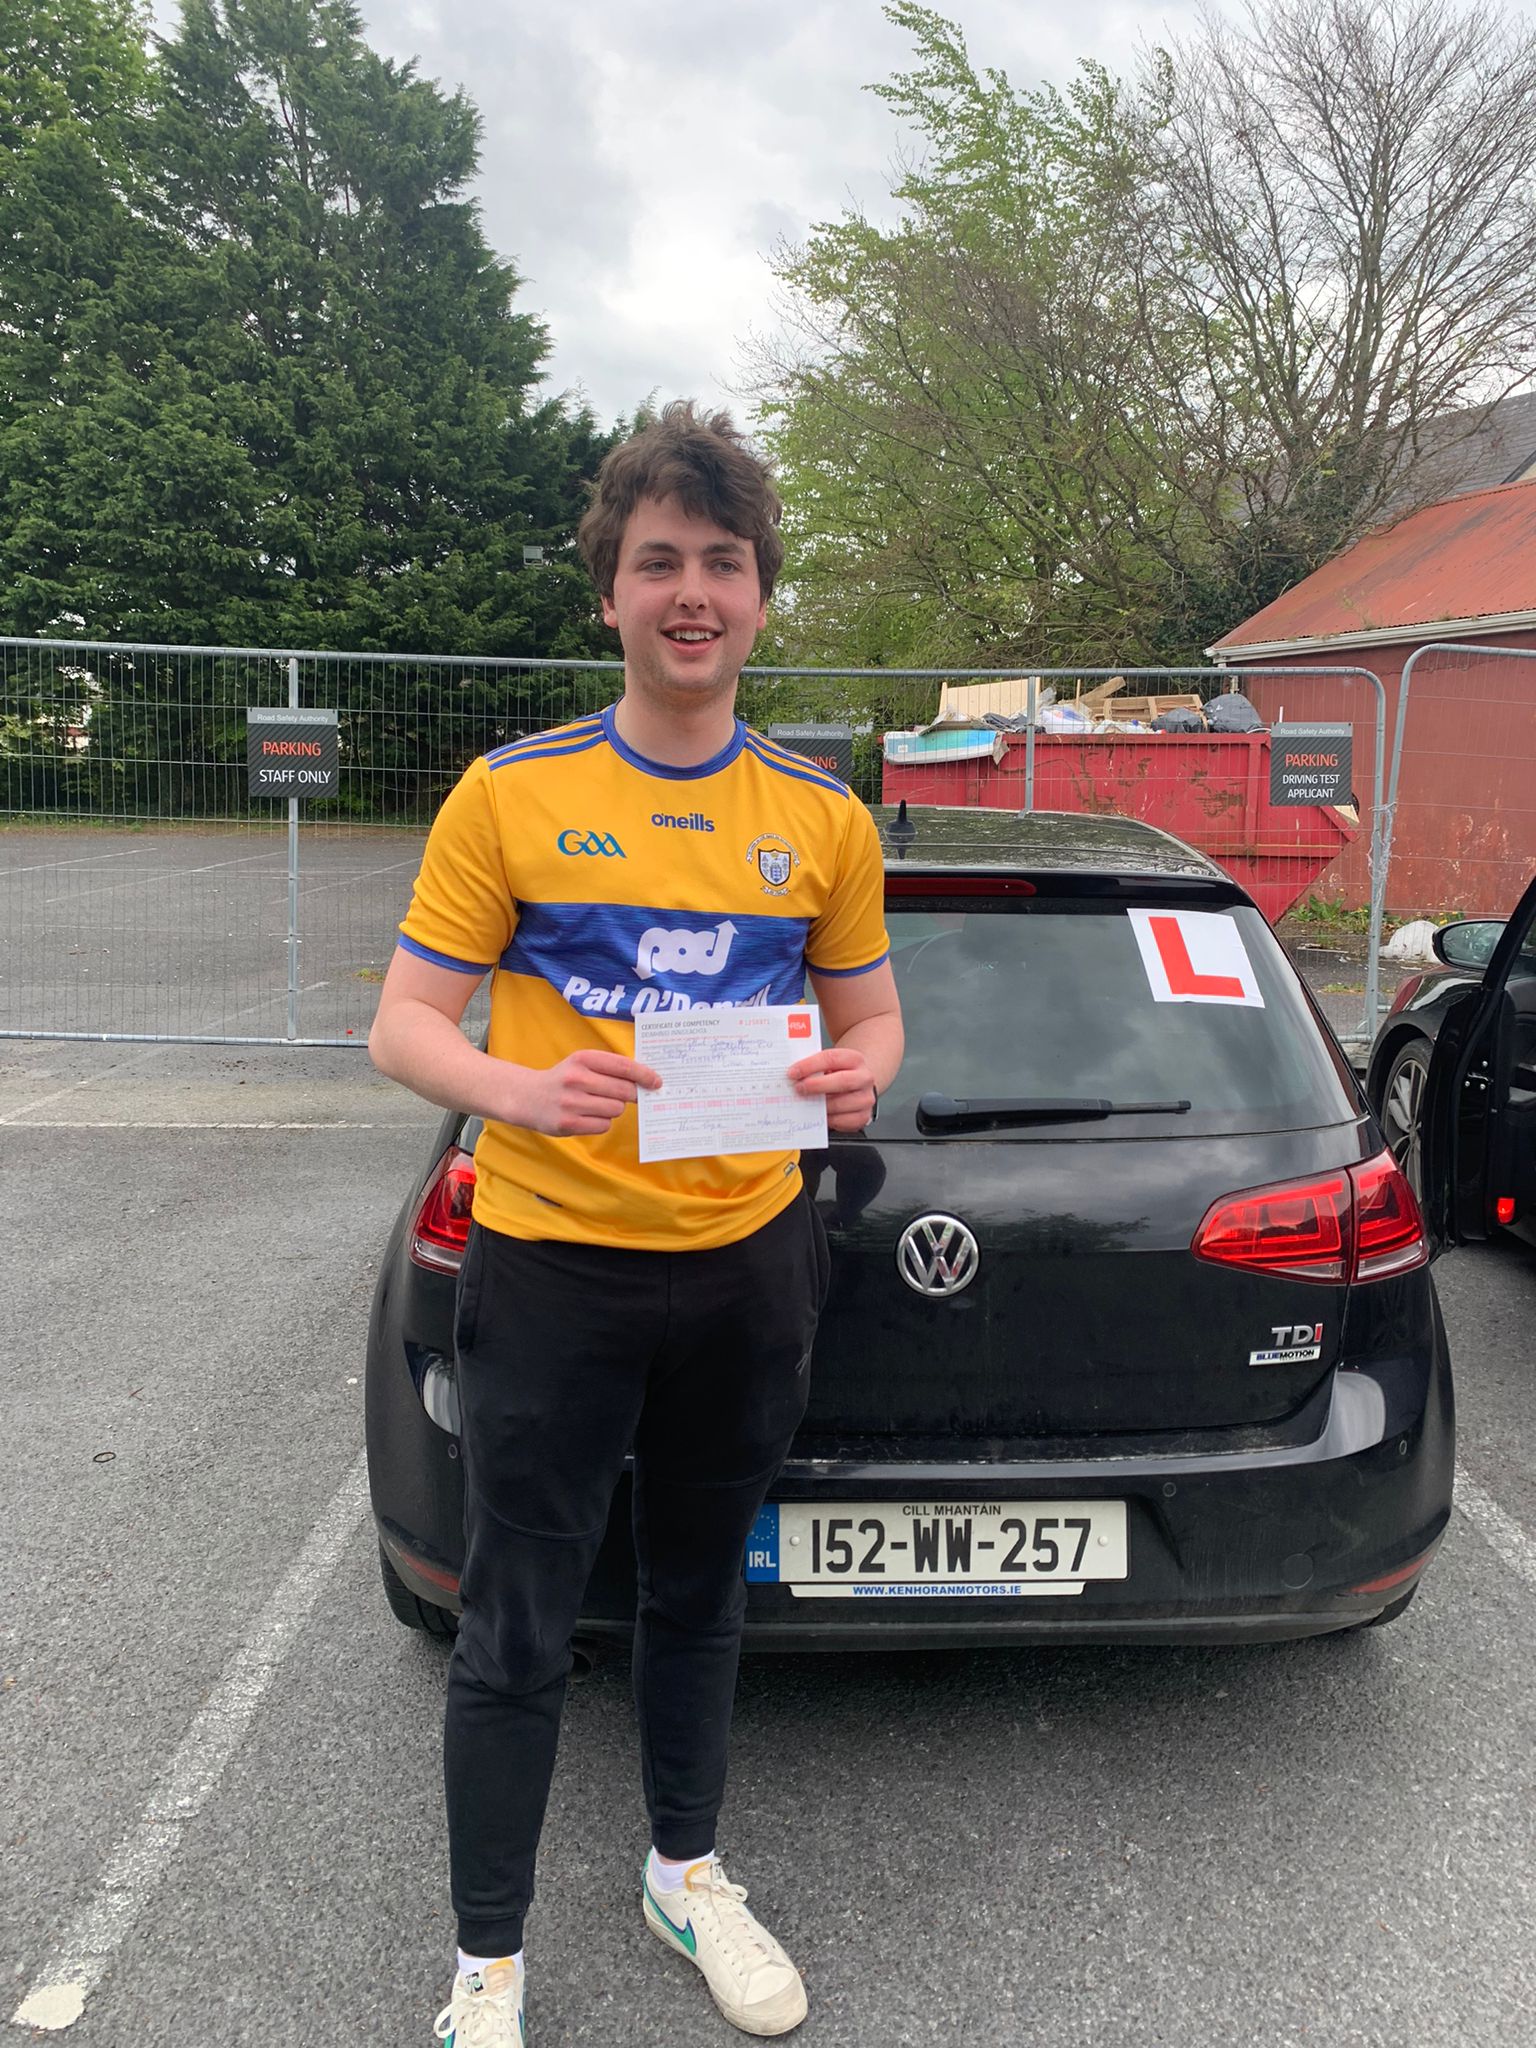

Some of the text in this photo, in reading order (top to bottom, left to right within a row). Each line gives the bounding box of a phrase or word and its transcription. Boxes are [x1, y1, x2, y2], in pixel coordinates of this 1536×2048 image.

[277, 714, 298, 723] Safety
[300, 715, 328, 724] Authority
[796, 729, 816, 738] Safety
[817, 730, 844, 738] Authority
[1298, 728, 1317, 736] Safety
[263, 741, 321, 756] PARKING
[1285, 753, 1338, 767] PARKING
[259, 769, 331, 784] STAFF ONLY
[1282, 774, 1340, 784] DRIVING TEST
[1287, 788, 1335, 798] APPLICANT
[1148, 916, 1245, 999] L
[562, 975, 626, 1014] Pat
[1271, 1323, 1323, 1347] TDI
[1256, 1350, 1315, 1361] BLUEMOTION
[902, 1505, 931, 1516] CILL
[812, 1518, 1091, 1574] 152-WW-257
[748, 1551, 777, 1568] IRL
[853, 1585, 1022, 1595] WWW.KENHORANMOTORS.IE
